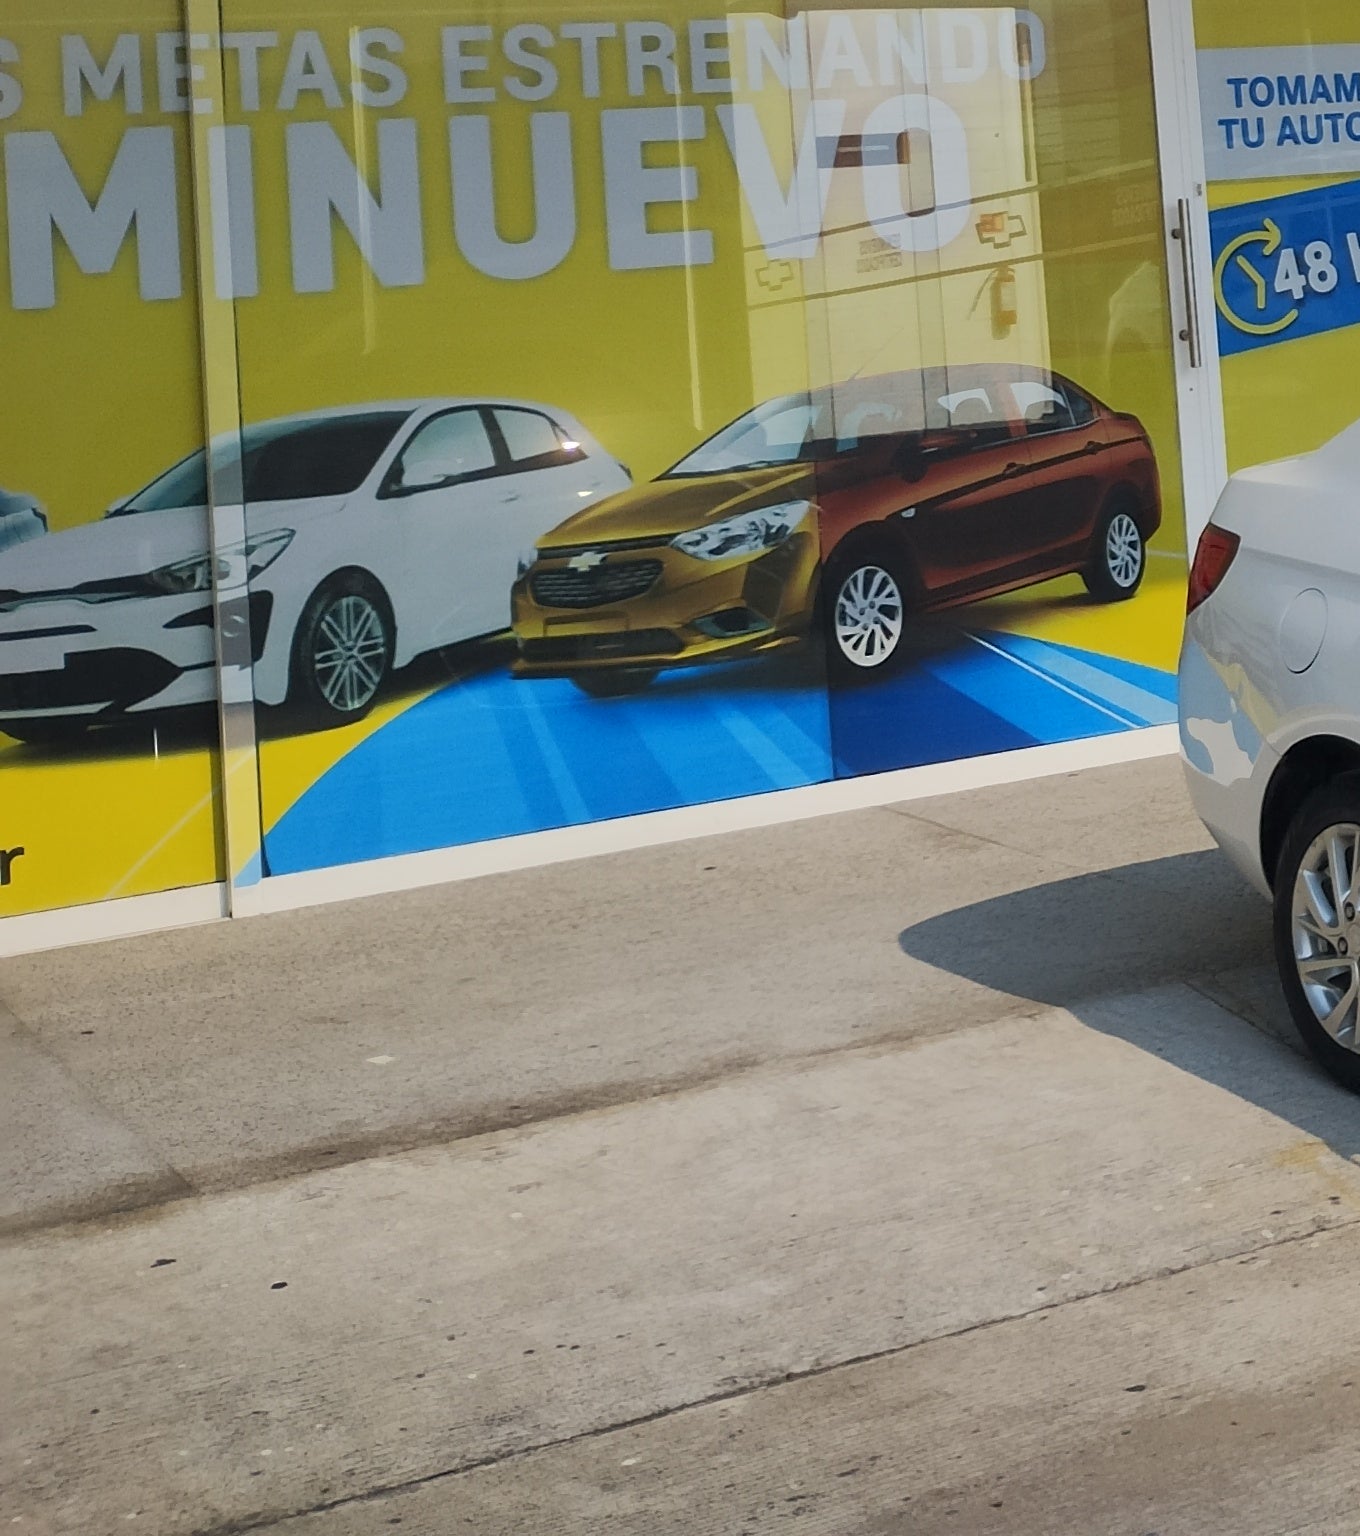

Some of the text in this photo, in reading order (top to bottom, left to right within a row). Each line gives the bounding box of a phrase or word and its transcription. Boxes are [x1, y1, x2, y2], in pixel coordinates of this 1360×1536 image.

[60, 26, 409, 118] METAS
[441, 8, 1046, 106] ESTRENANDO
[1217, 117, 1265, 150] TU
[1273, 240, 1338, 300] 48
